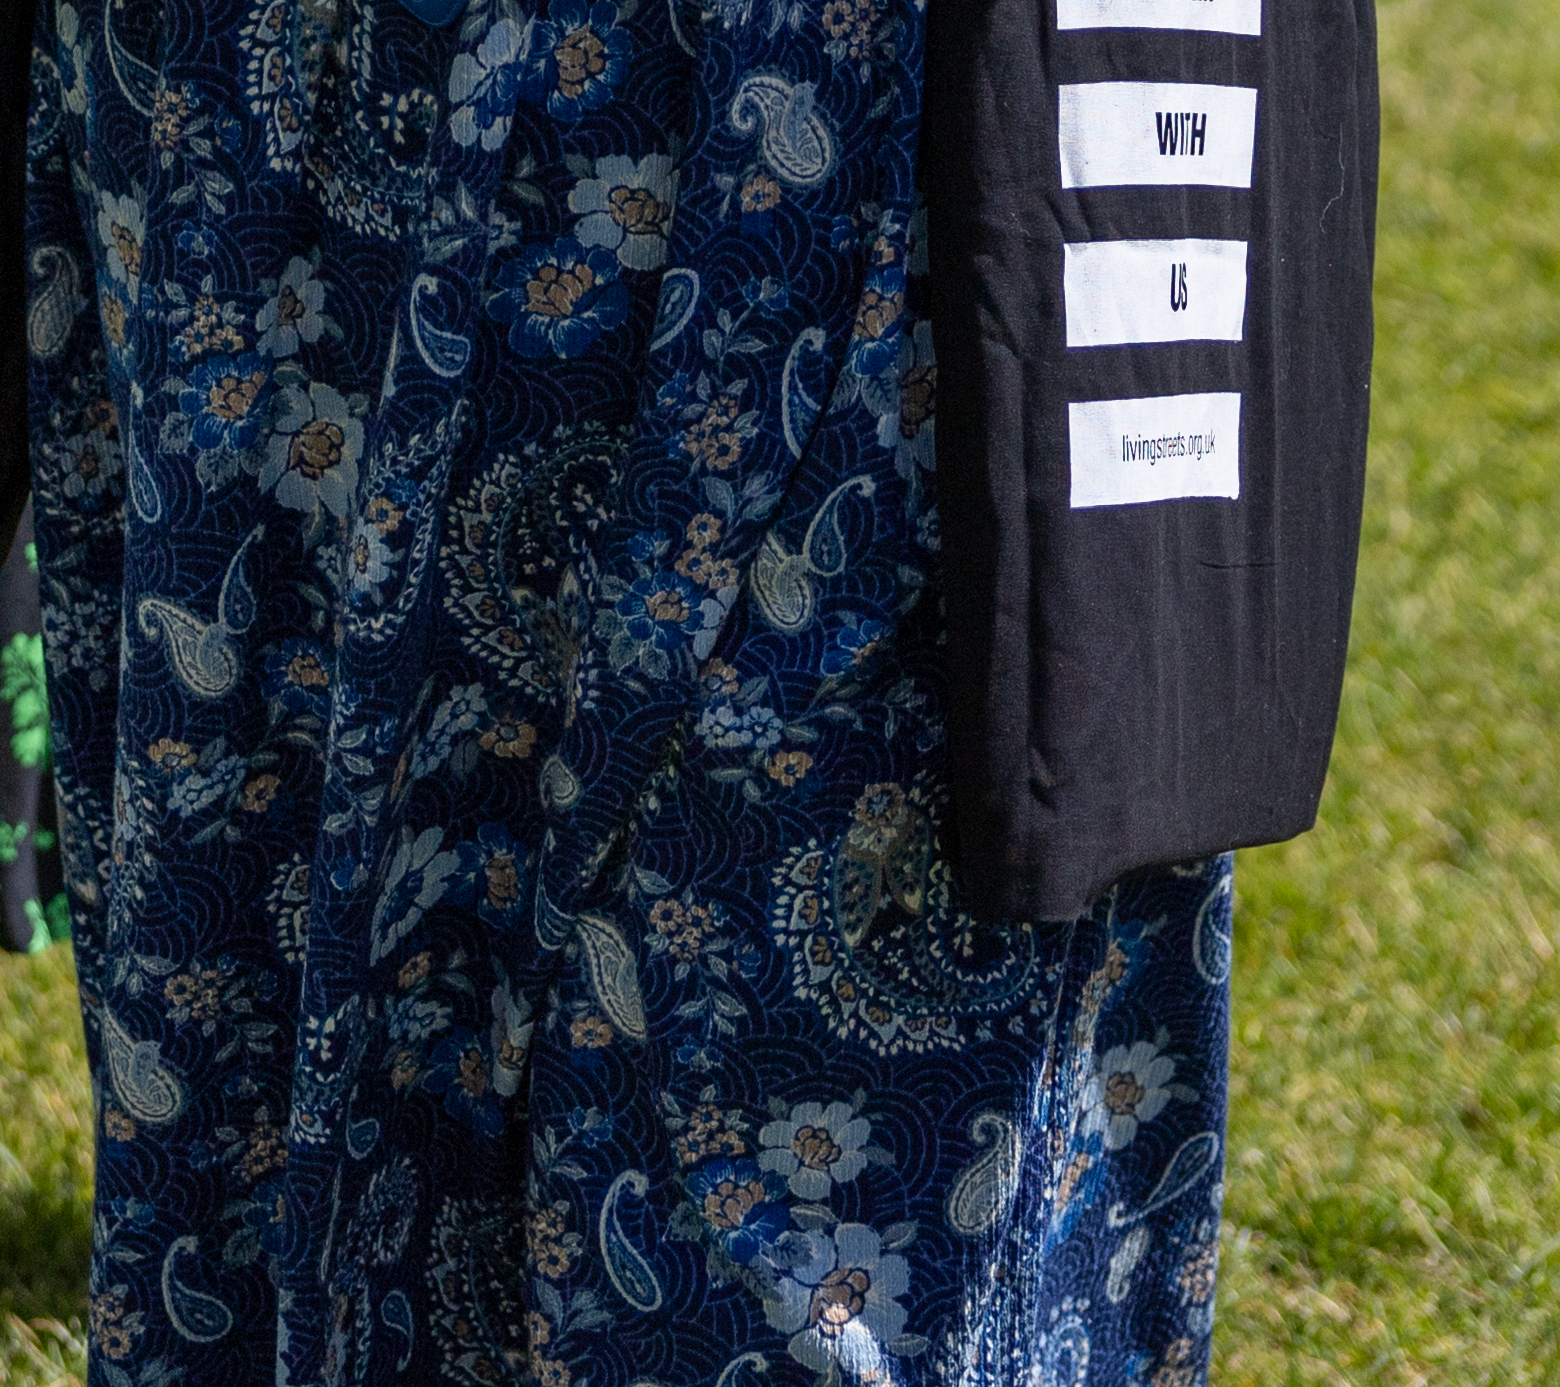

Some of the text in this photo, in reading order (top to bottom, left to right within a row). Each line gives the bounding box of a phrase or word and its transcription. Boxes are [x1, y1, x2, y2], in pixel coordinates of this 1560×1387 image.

[1155, 111, 1207, 156] WITH
[1170, 262, 1188, 313] US
[1122, 427, 1216, 466] livingstreets.org.uk
